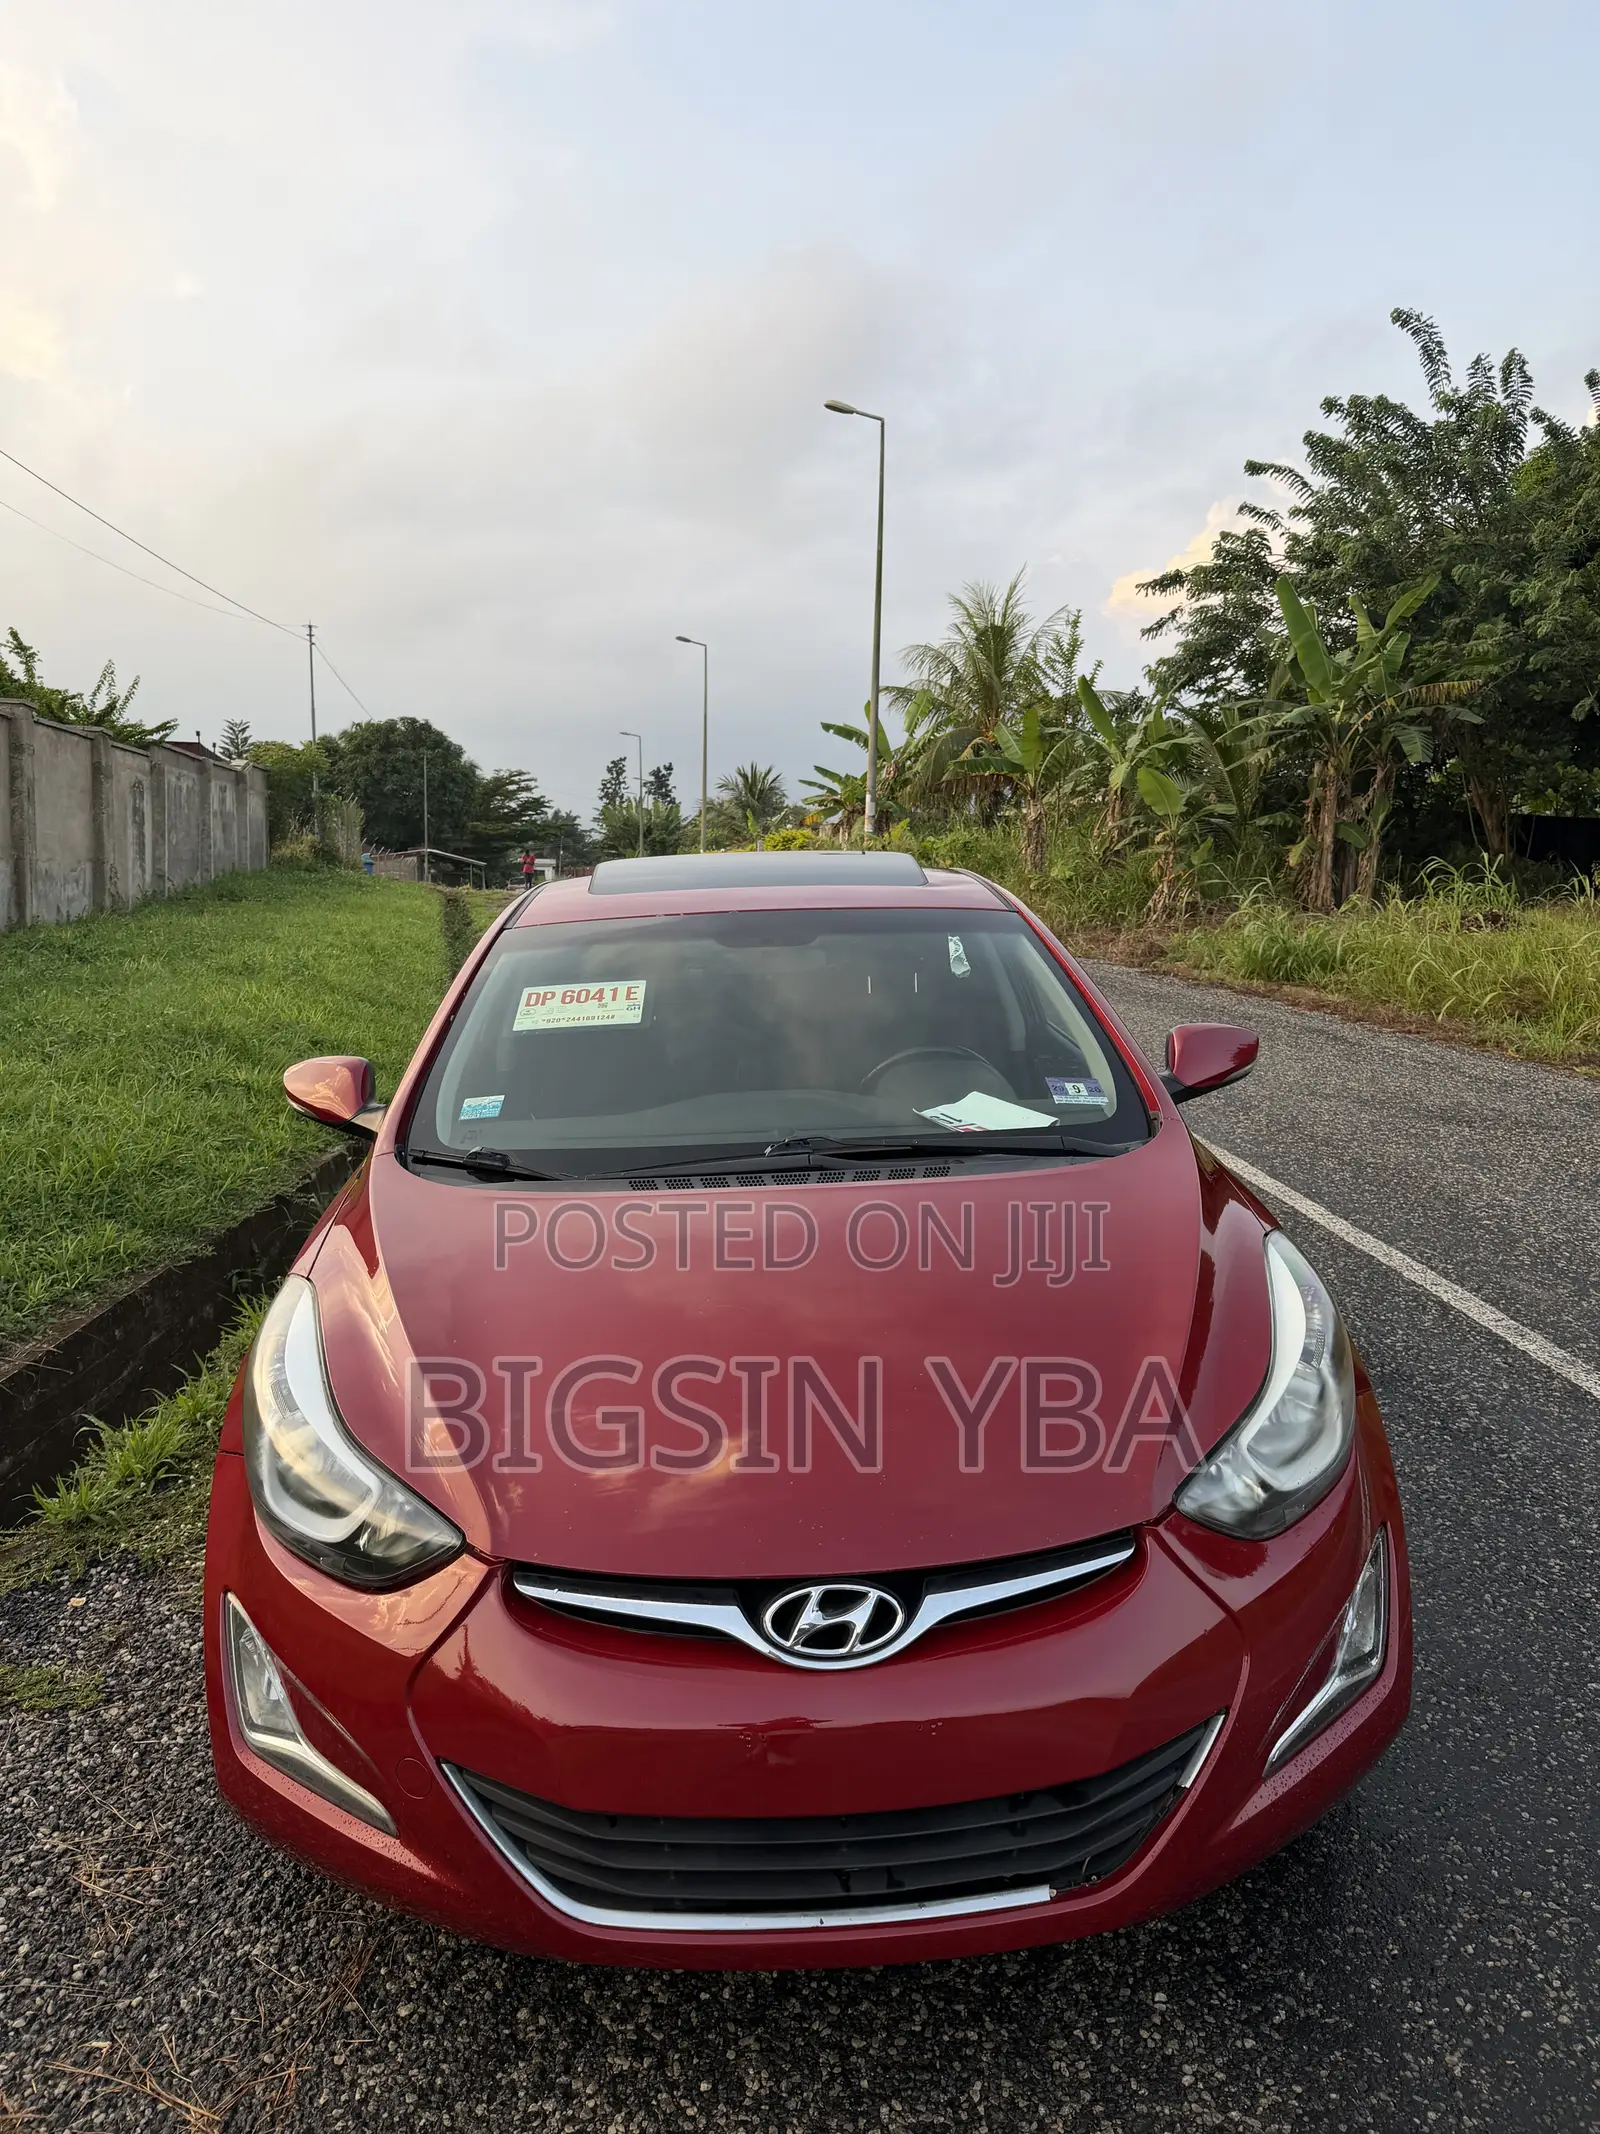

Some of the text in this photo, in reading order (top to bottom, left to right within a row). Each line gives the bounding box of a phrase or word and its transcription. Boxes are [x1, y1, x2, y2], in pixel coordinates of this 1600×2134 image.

[525, 986, 640, 1007] DP 6041 E
[1072, 1084, 1081, 1094] 9
